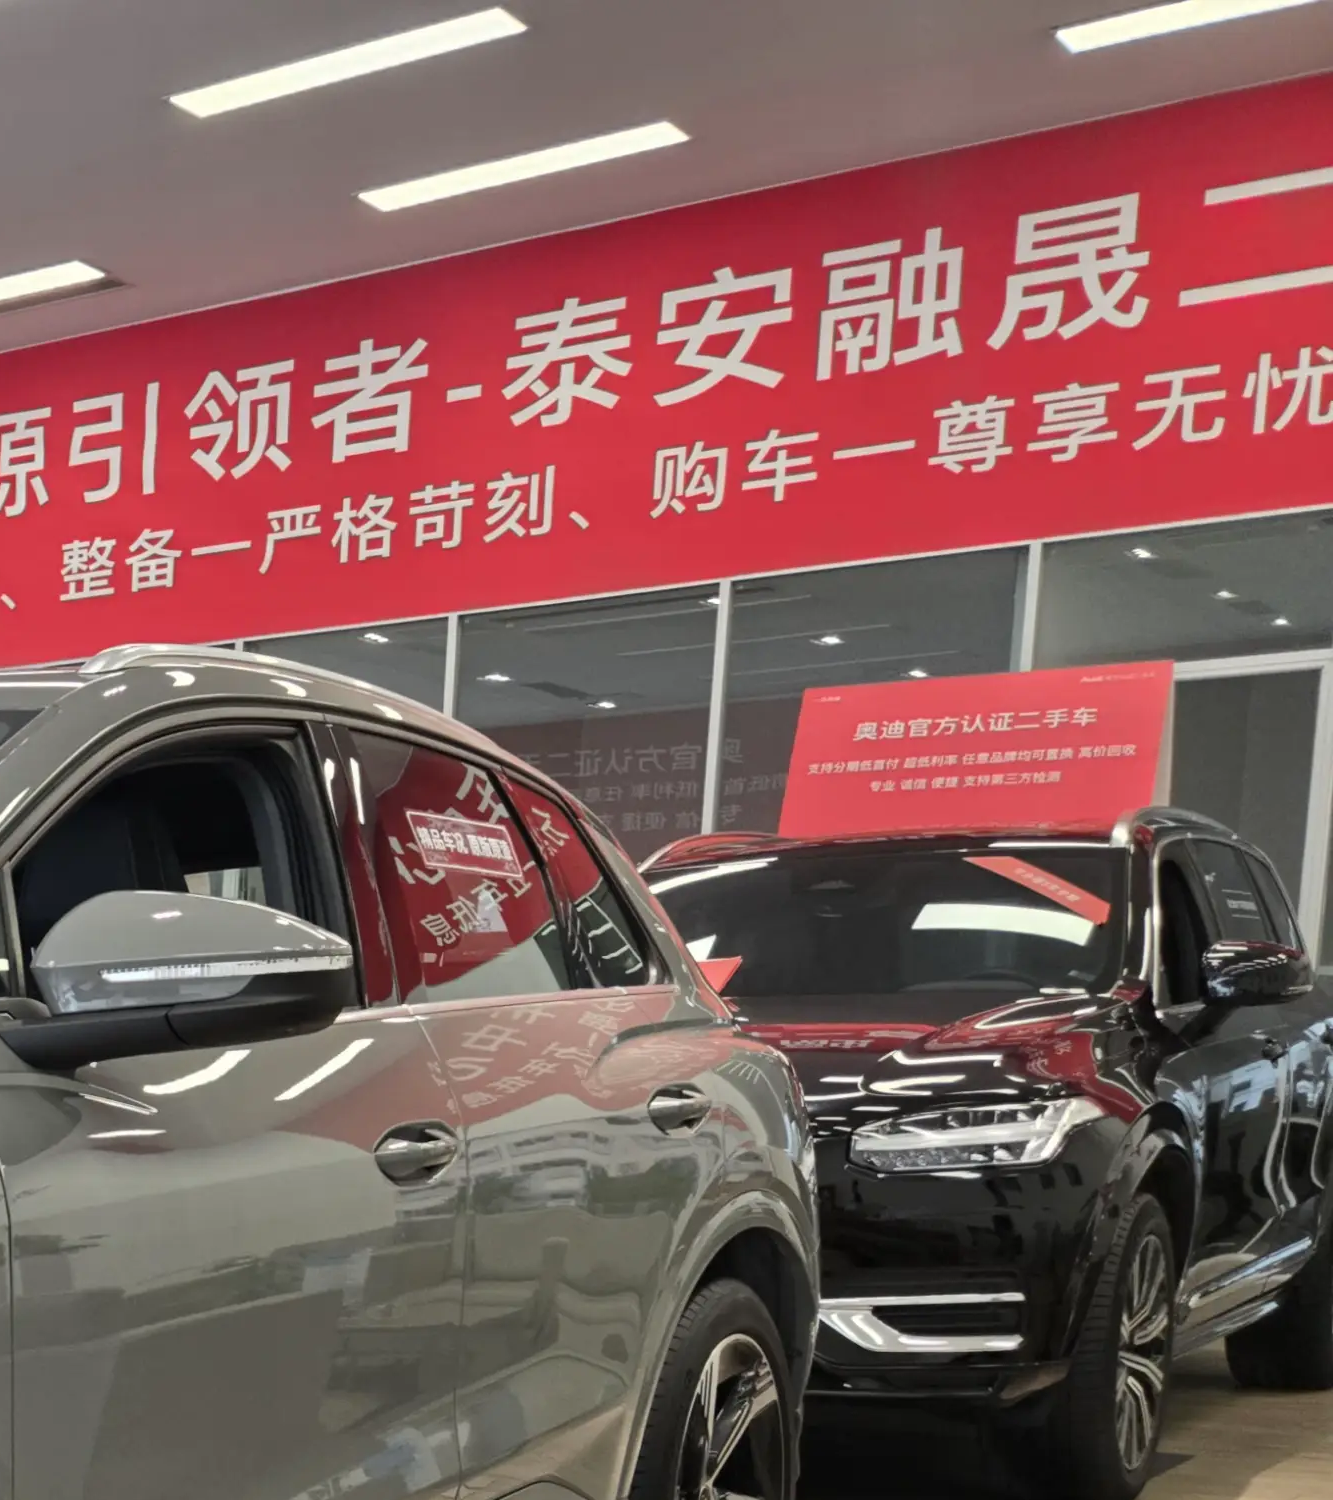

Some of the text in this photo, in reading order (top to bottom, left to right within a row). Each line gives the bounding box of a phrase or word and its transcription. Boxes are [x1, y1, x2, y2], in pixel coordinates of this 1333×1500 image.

[852, 706, 1098, 742] 奥迪官方认证二手车
